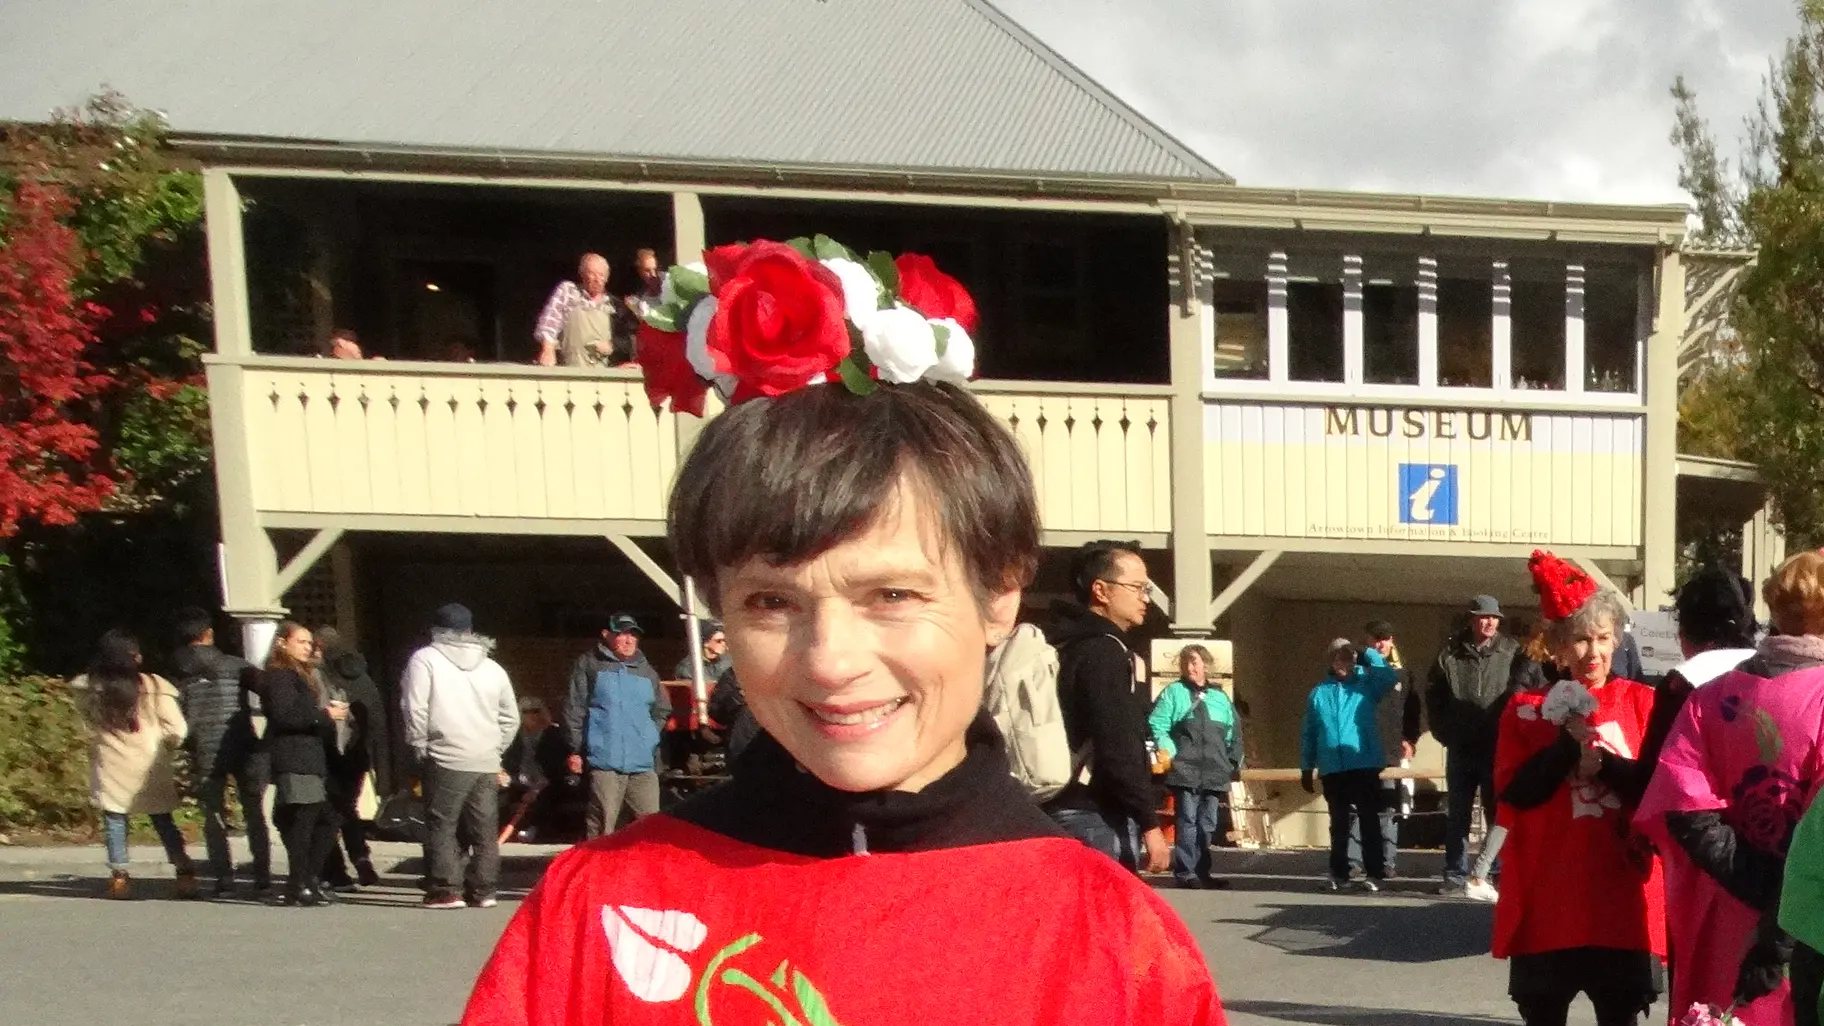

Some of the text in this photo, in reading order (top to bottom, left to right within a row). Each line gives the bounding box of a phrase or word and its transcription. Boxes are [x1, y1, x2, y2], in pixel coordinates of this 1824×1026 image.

[1326, 405, 1533, 441] MUSEUM
[1308, 523, 1549, 539] Arrowtown Information & Booking Centre
